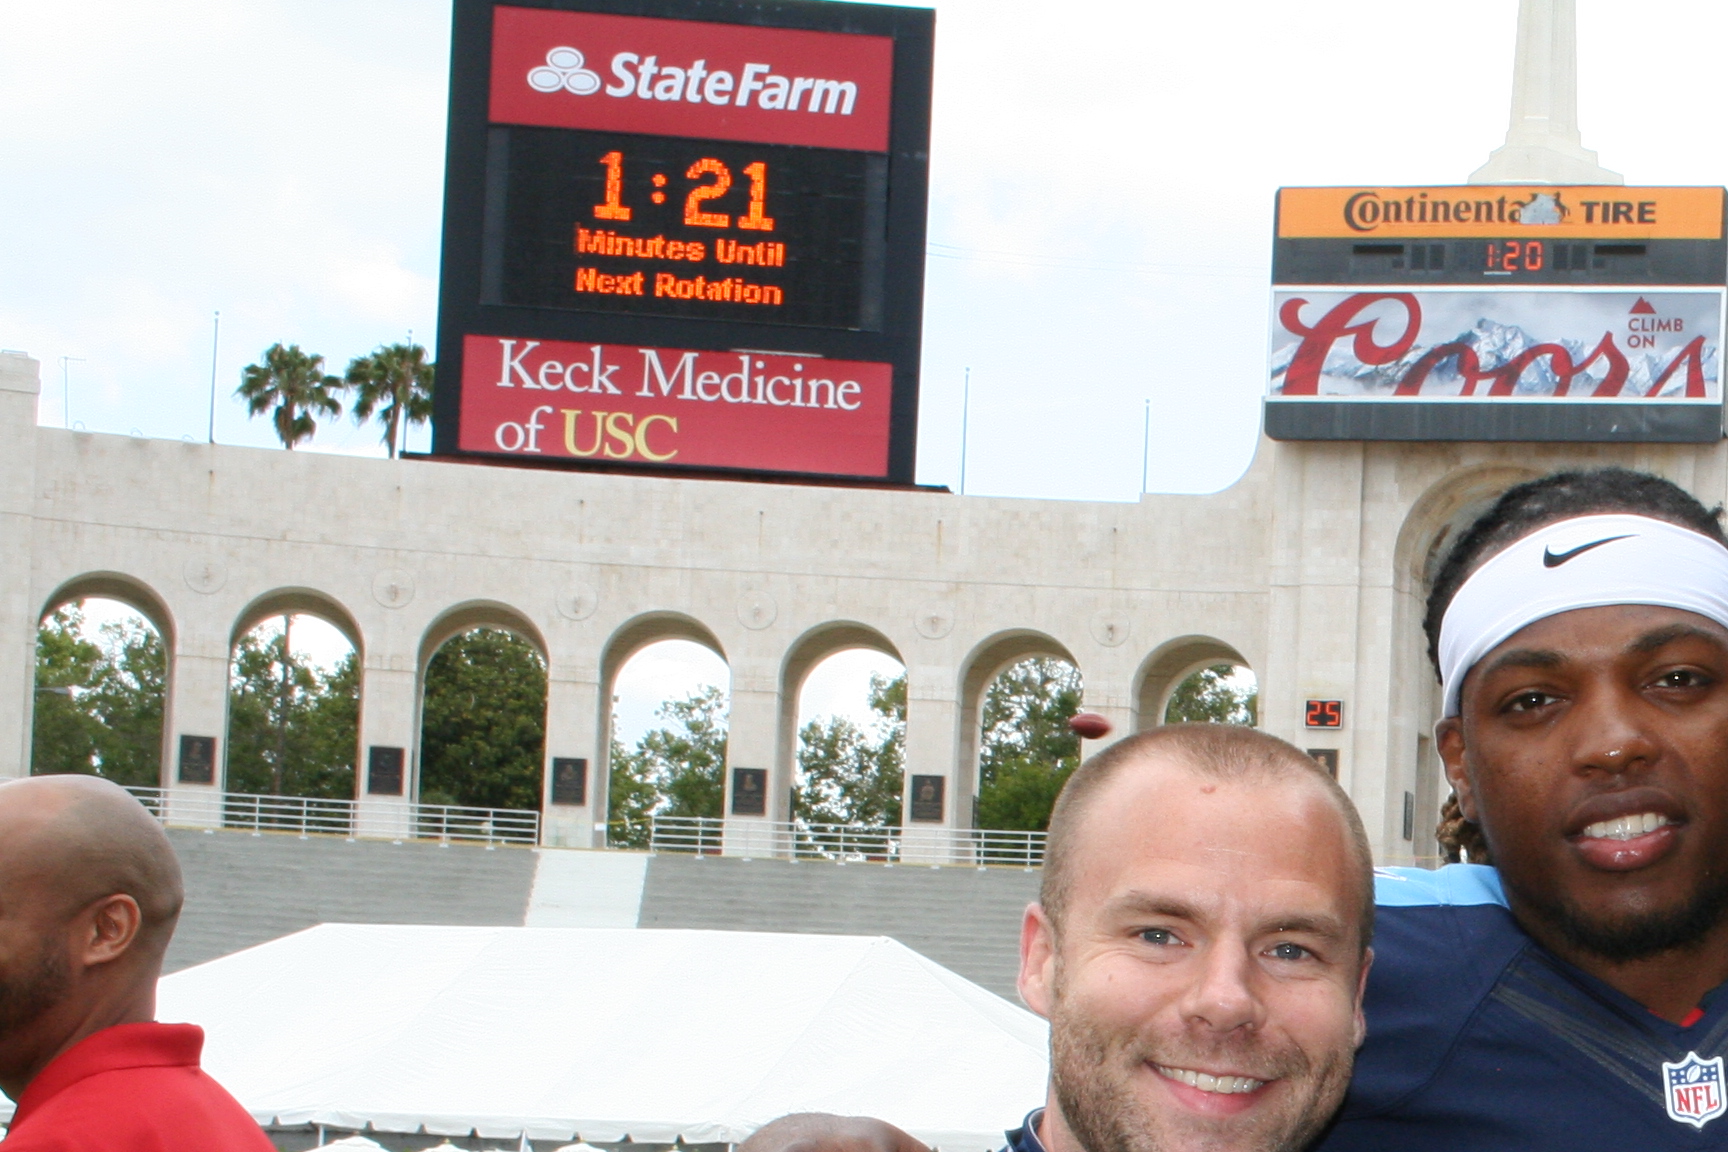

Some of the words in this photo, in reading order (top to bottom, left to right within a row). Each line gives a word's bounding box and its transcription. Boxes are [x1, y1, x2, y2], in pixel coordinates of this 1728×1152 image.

[593, 151, 774, 232] 1:21
[1344, 192, 1537, 231] Continenta
[1580, 201, 1656, 224] TIRE
[576, 227, 705, 262] Minutes
[716, 238, 785, 268] Until
[1486, 241, 1543, 271] 1:20
[575, 267, 644, 296] Next
[655, 272, 783, 306] Rotation
[1627, 335, 1655, 348] ON
[1628, 318, 1683, 333] CLIMB
[496, 340, 621, 395] Keck
[635, 349, 862, 411] Medicine
[494, 406, 553, 453] of
[560, 409, 679, 462] USC
[1306, 701, 1340, 726] 25
[1675, 1085, 1717, 1115] NFL
